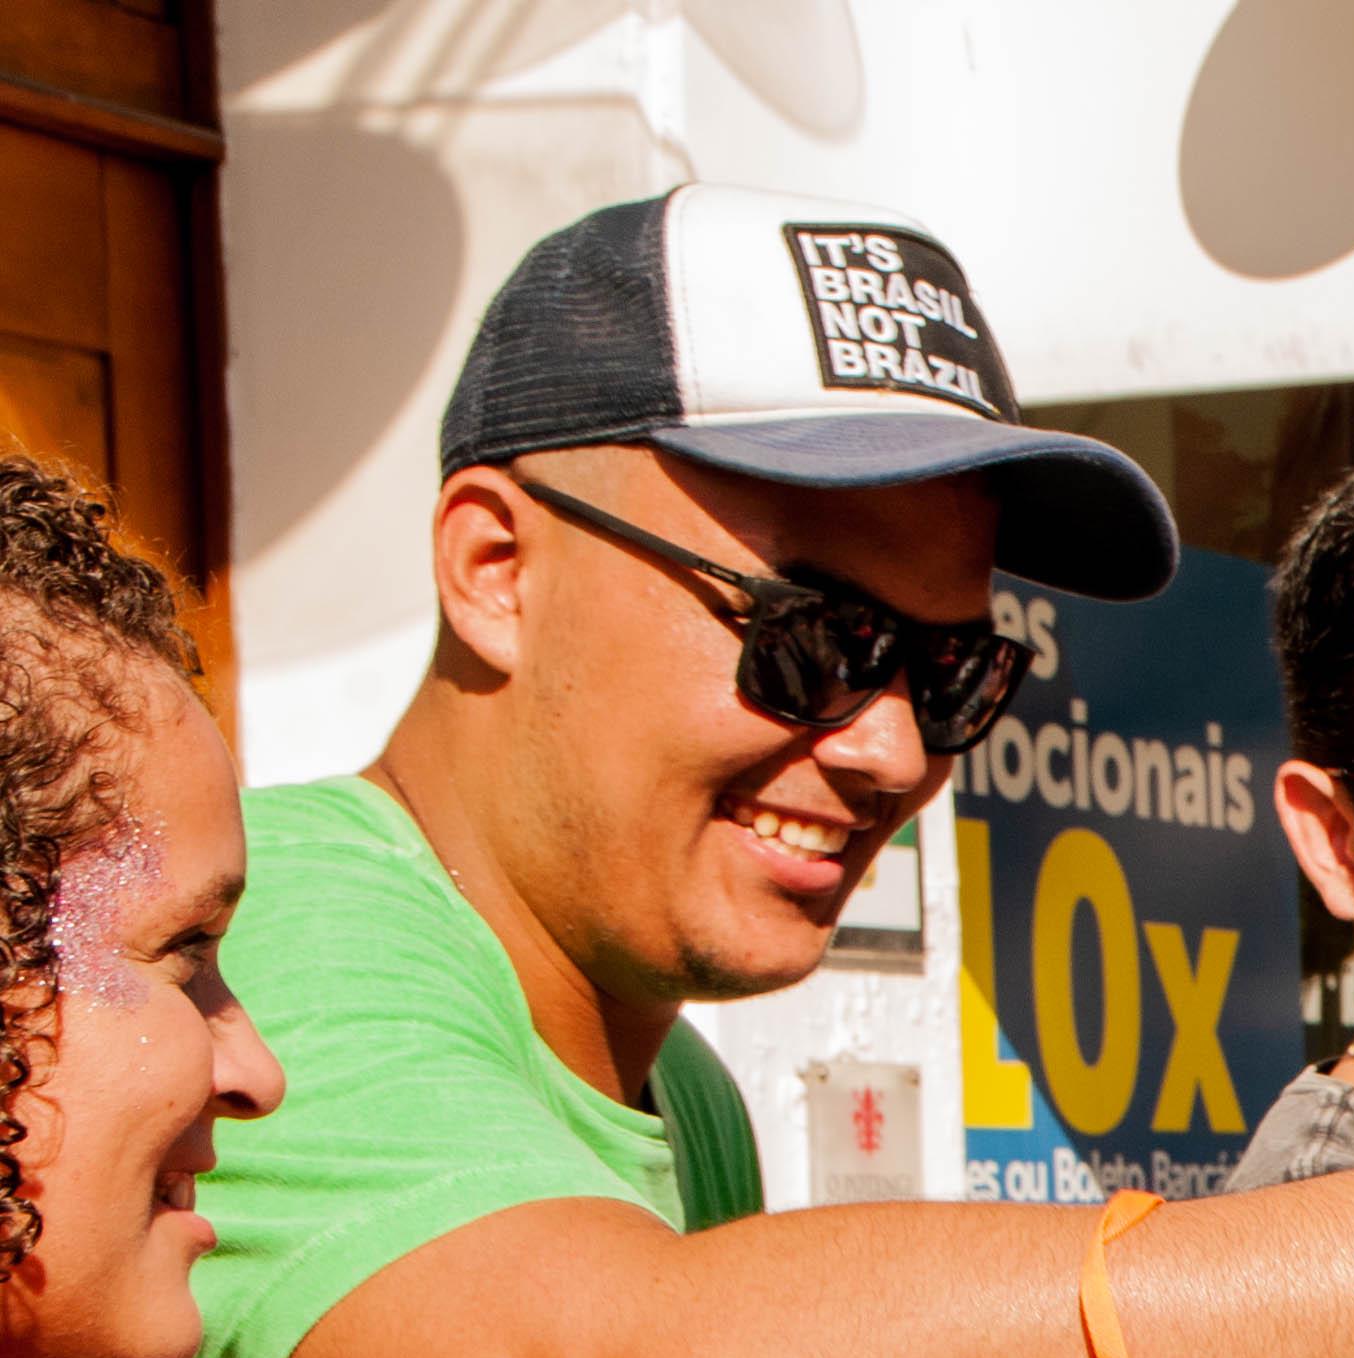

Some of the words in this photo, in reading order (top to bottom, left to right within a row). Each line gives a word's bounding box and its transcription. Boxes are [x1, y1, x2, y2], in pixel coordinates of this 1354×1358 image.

[797, 232, 903, 273] IT'S
[809, 266, 977, 339] BRASIL
[818, 300, 926, 349] NOT
[828, 338, 1001, 415] BRAZIL
[1005, 1160, 1048, 1200] ou
[1053, 1147, 1146, 1201] Boleto
